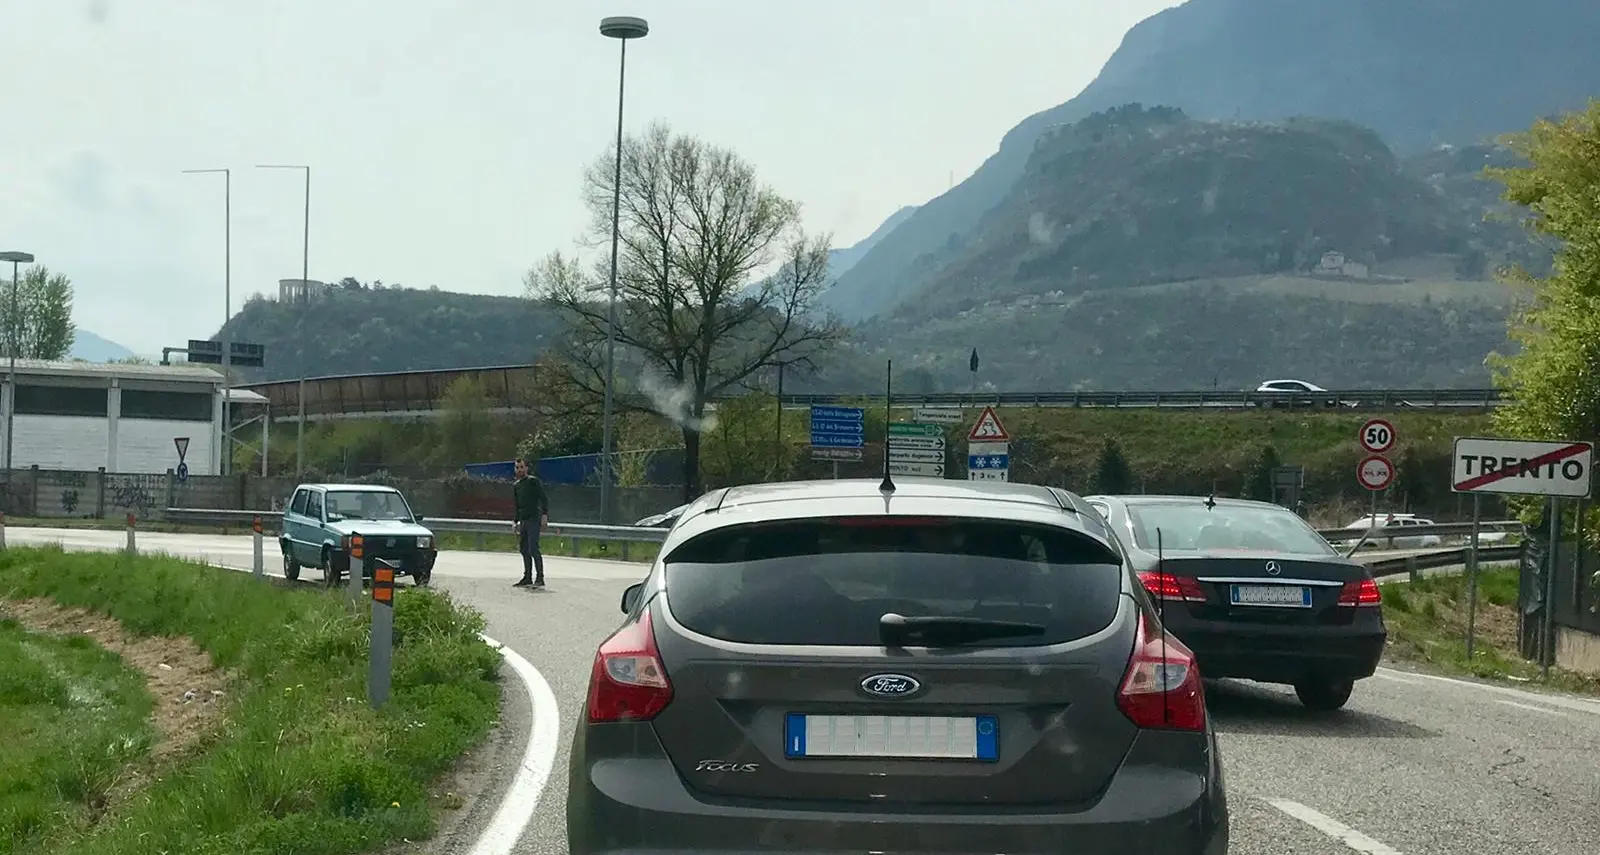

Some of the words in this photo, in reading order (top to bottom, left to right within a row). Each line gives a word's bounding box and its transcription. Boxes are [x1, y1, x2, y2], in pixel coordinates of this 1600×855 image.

[1366, 428, 1388, 445] 50
[1461, 455, 1583, 481] TRENTO
[873, 678, 907, 694] Ford
